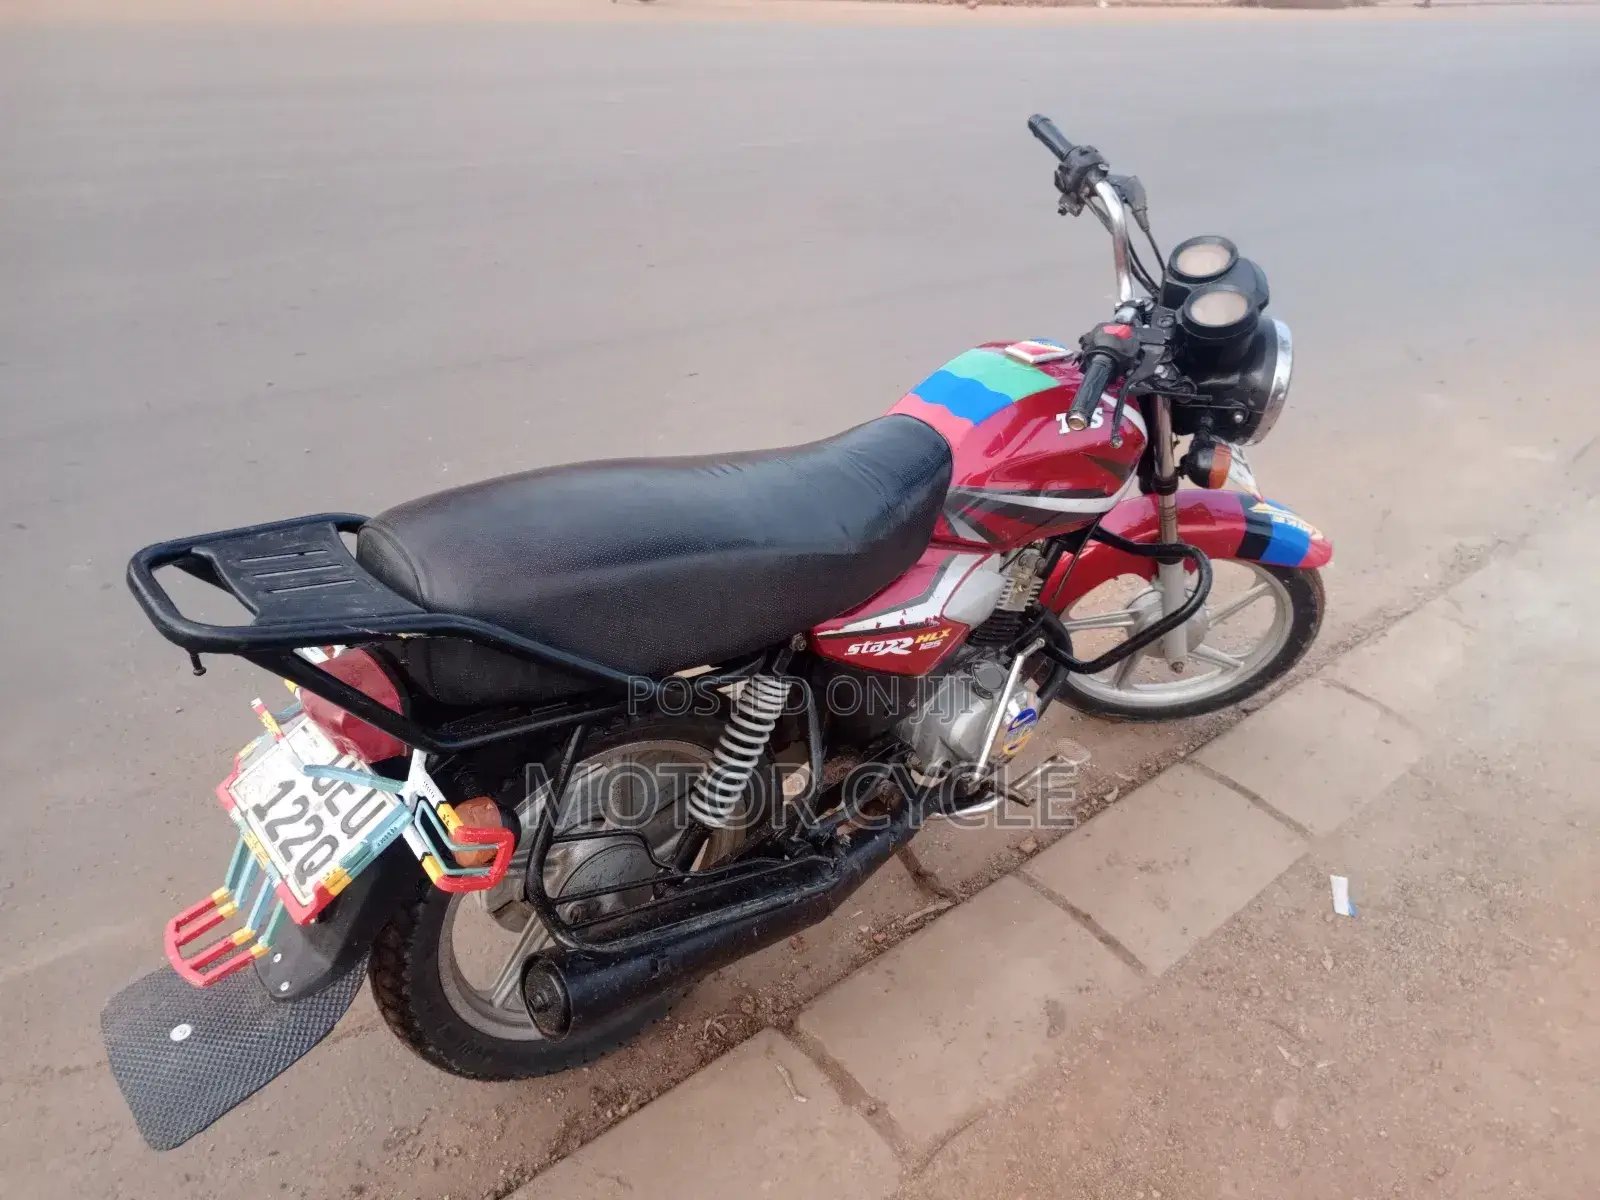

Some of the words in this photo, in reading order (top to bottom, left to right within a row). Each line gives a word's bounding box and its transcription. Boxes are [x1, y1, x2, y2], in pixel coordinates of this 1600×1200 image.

[1056, 408, 1104, 434] TS
[915, 629, 951, 643] HLX
[919, 640, 943, 650] 125
[252, 780, 339, 885] 122Q
